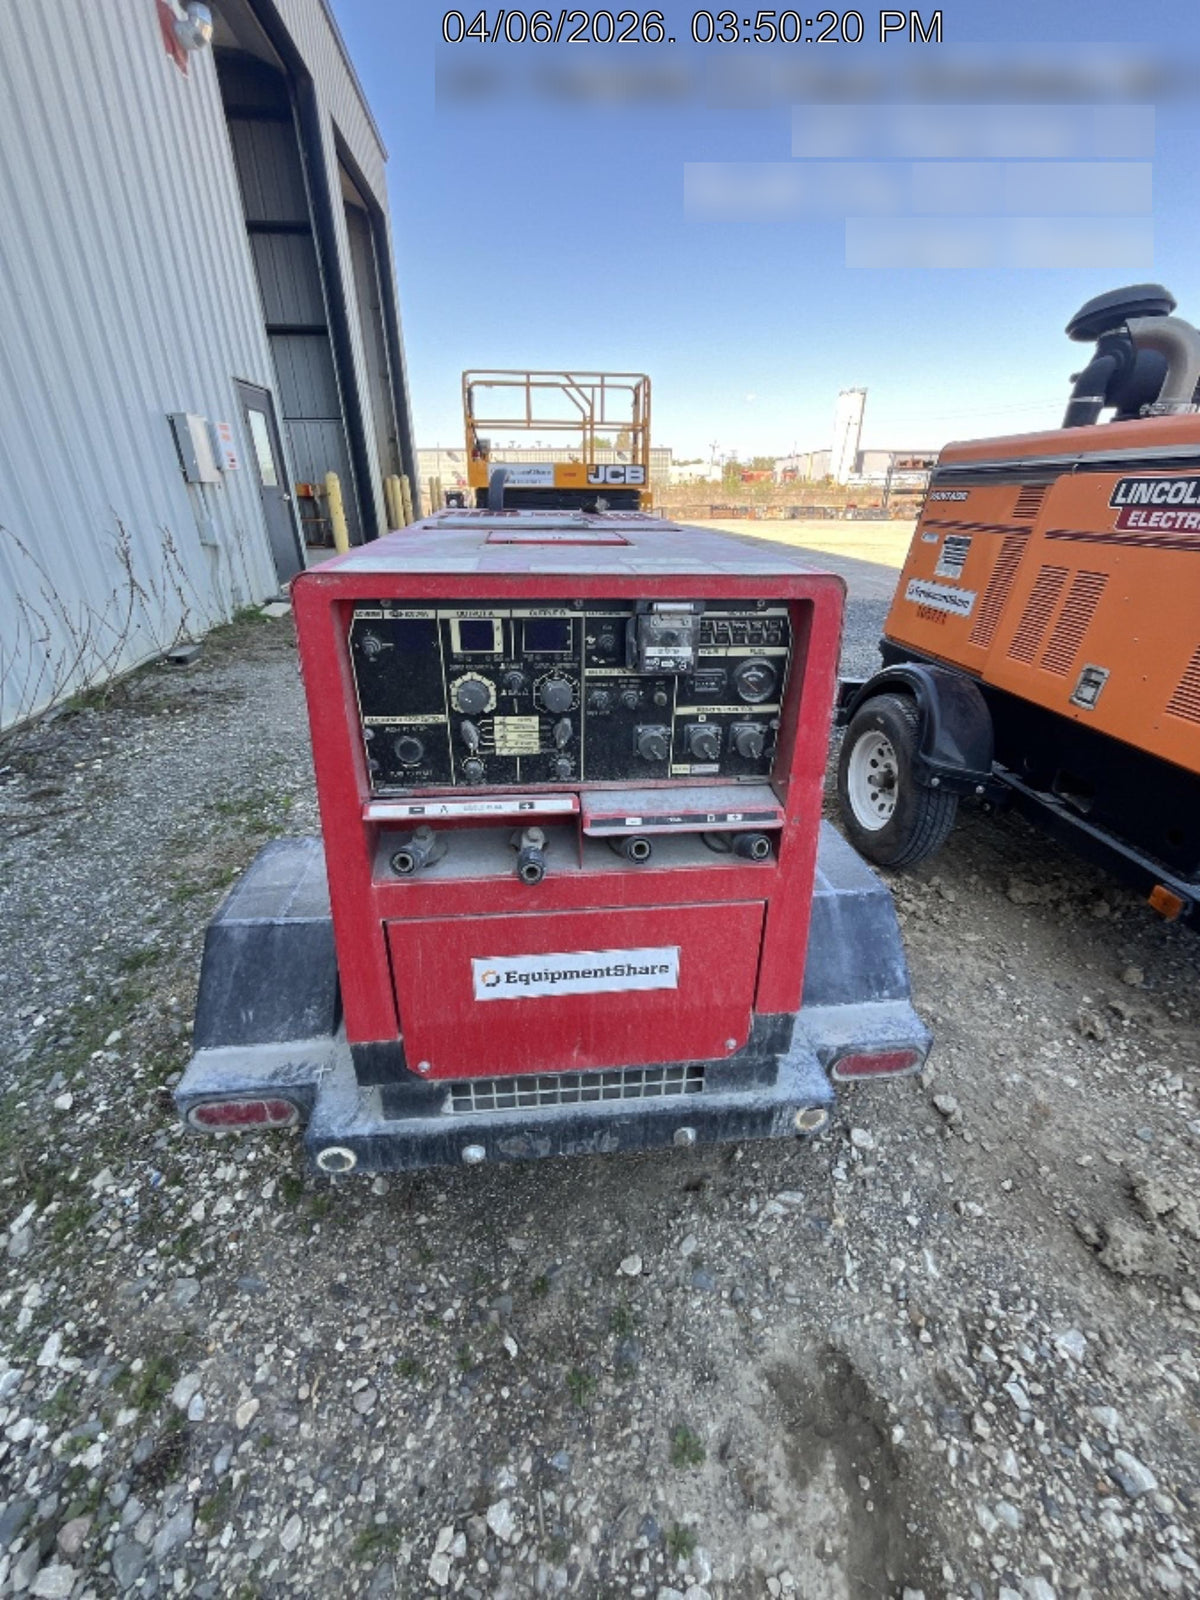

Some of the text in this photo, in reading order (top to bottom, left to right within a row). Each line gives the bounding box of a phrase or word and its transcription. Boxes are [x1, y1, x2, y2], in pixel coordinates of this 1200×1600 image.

[588, 465, 645, 484] JCB
[1114, 481, 1200, 504] LINCOL
[1127, 510, 1200, 530] ELECTR
[505, 963, 669, 986] EquipmentShare
